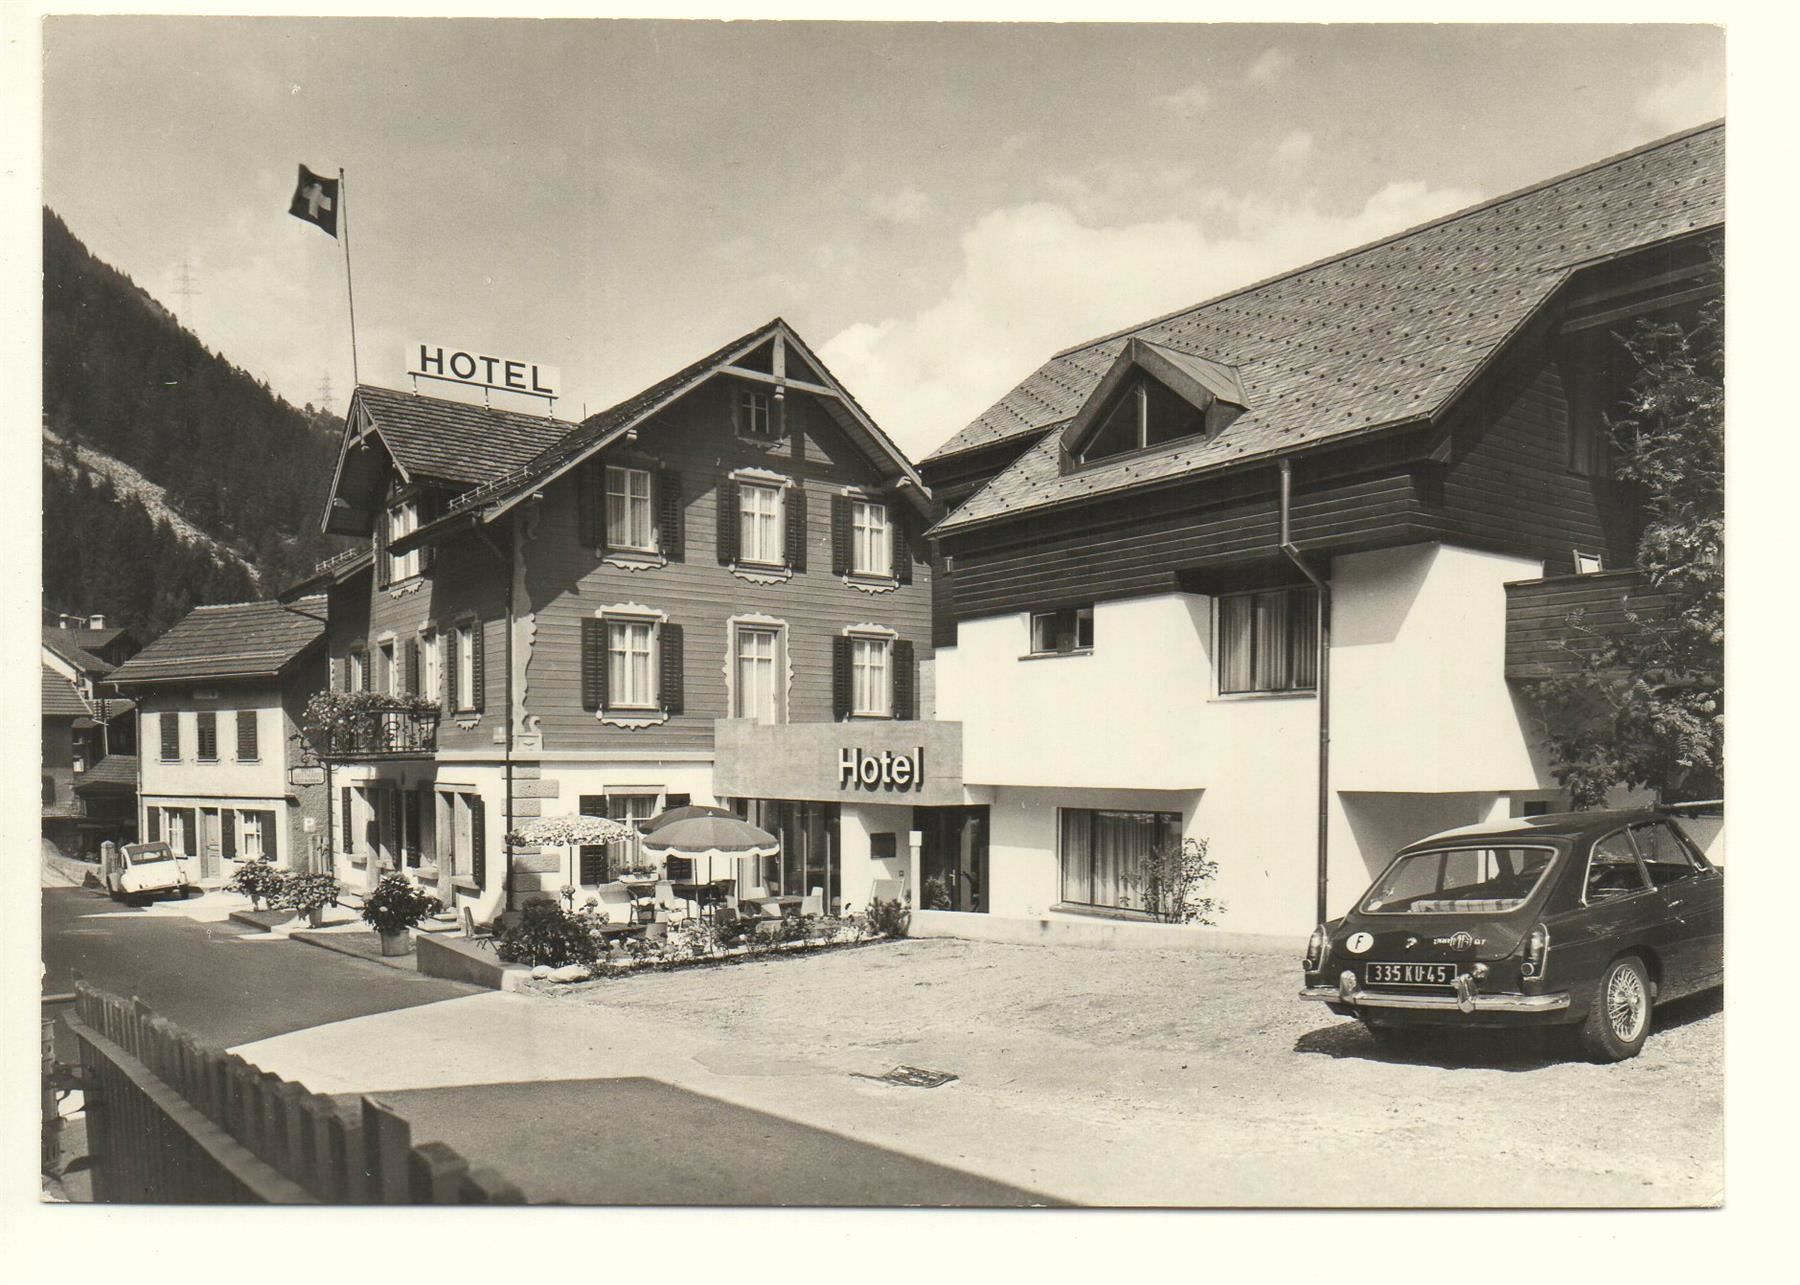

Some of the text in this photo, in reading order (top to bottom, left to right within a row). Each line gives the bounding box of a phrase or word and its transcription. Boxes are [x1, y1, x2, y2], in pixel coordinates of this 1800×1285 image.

[420, 344, 553, 394] HOTEL
[838, 747, 921, 786] Hotel
[1354, 935, 1365, 950] F
[1375, 965, 1402, 982] 335
[1427, 966, 1446, 983] 45
